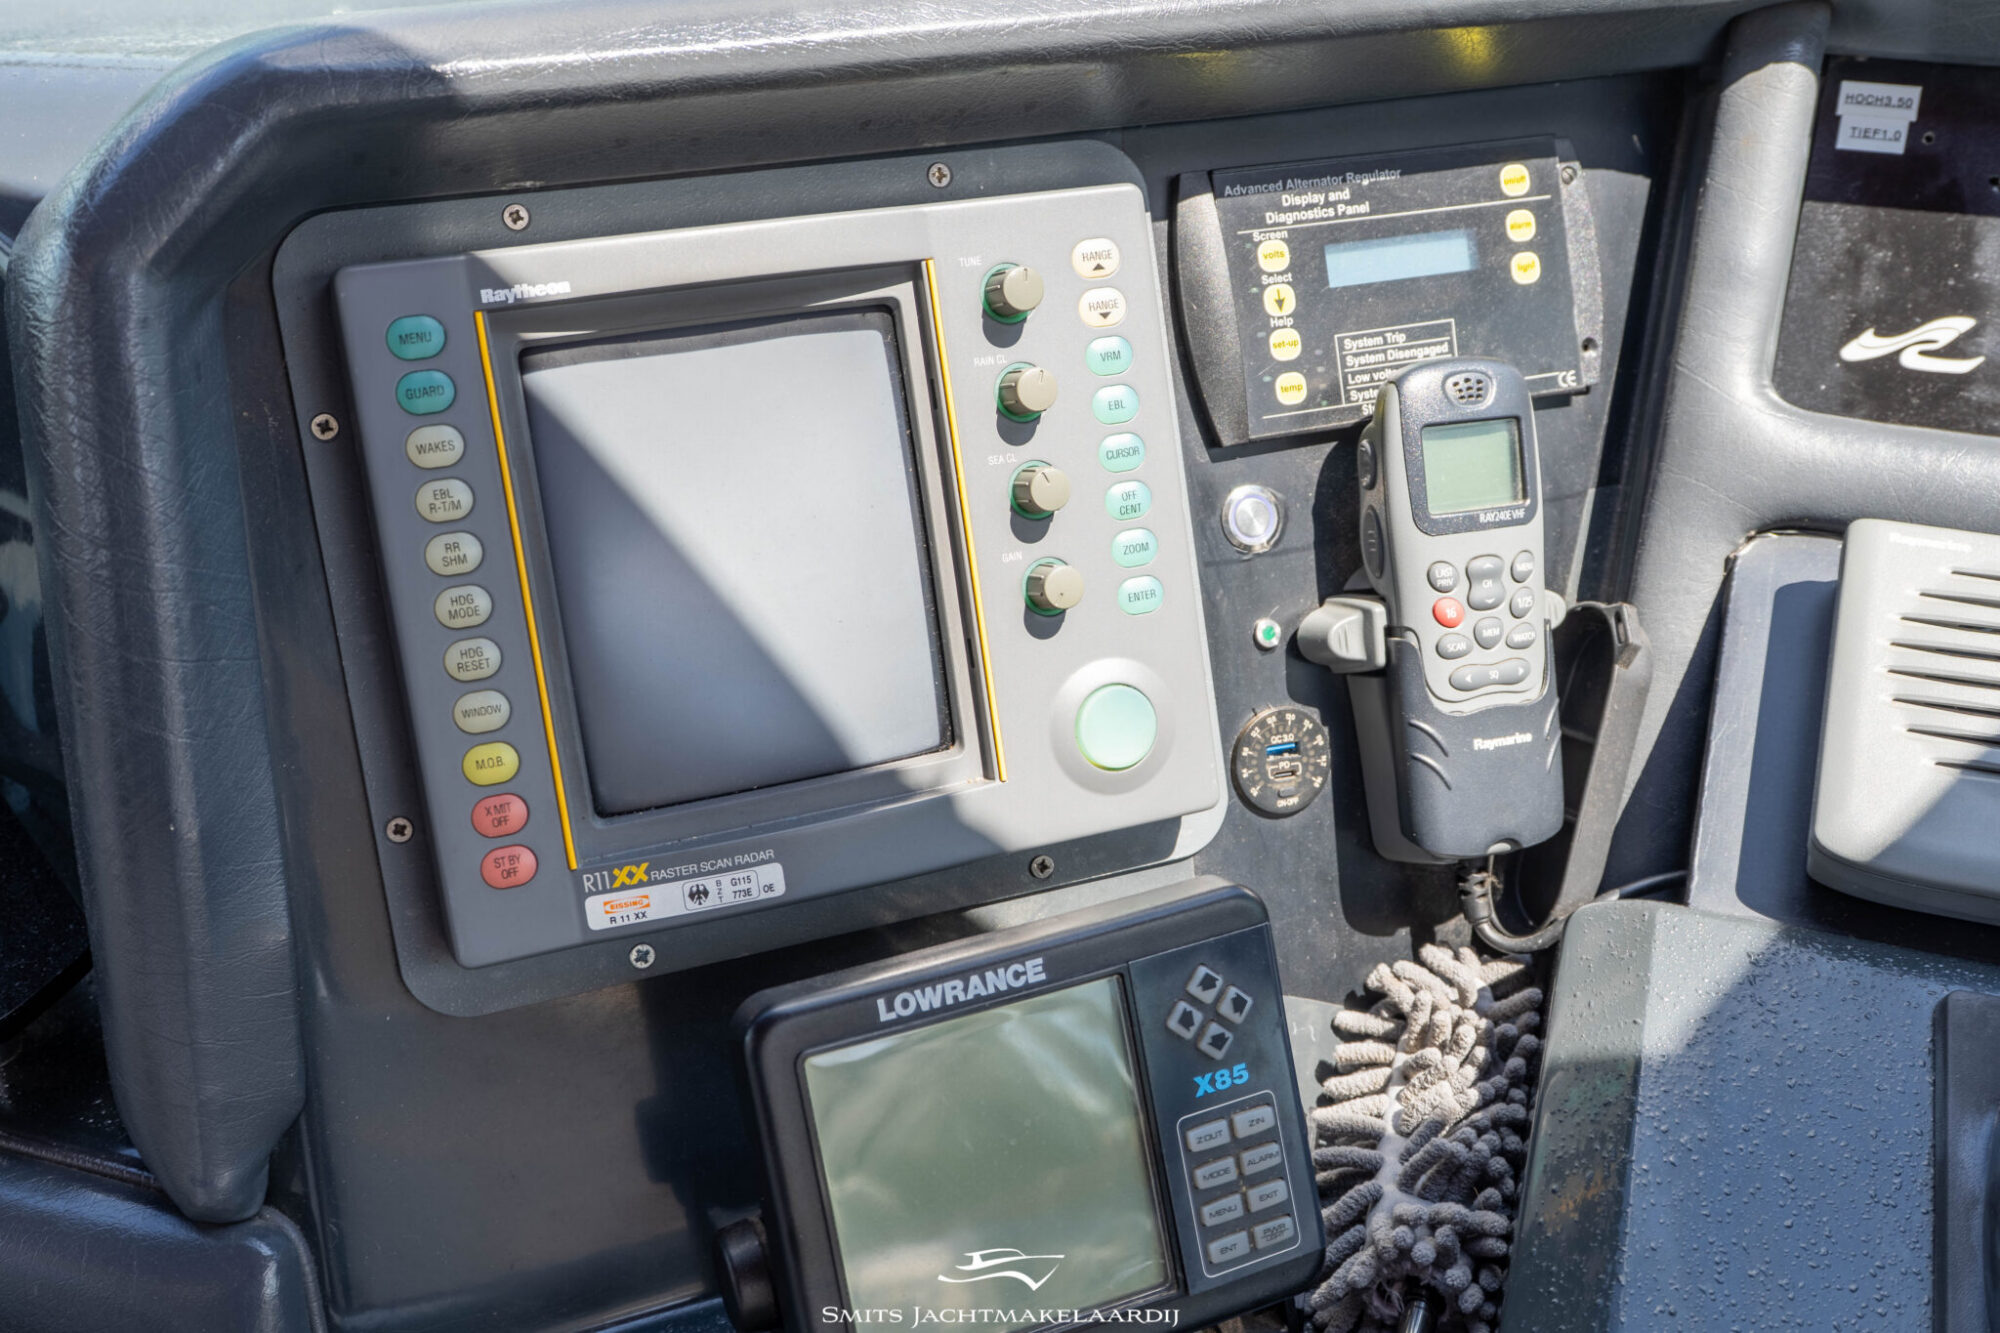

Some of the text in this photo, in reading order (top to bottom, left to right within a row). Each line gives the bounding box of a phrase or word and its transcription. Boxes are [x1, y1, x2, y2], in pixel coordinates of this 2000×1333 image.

[1224, 169, 1401, 197] Advanced Alternator Regulator
[1281, 189, 1350, 207] Display and
[1265, 202, 1370, 225] Diagnostics Panel
[1252, 231, 1288, 242] Screen
[958, 256, 982, 267] TUNE
[1263, 251, 1285, 259] volts
[1261, 272, 1292, 285] Select
[480, 281, 571, 304] Raytheon
[1270, 316, 1293, 328] Help
[399, 332, 432, 345] MENU
[1272, 337, 1299, 349] set-up
[1344, 331, 1406, 351] System Trip
[974, 355, 1007, 367] RAIN CL
[1100, 350, 1121, 362] VRM
[1346, 342, 1448, 367] System Disengaged
[1348, 368, 1399, 384] Low volt
[405, 385, 444, 400] GUARD
[1280, 383, 1303, 395] temp
[1108, 400, 1126, 410] EBL
[416, 440, 455, 455] WAKES
[1106, 446, 1140, 460] CURSOR
[988, 453, 1017, 465] SEA CL
[433, 488, 453, 500] EBL
[1122, 491, 1136, 501] OFF
[429, 500, 462, 514] R-T/M
[1120, 503, 1142, 515] CENT
[1480, 508, 1525, 523] RAY240E VHF
[445, 542, 460, 554] RR
[1123, 542, 1149, 555] ZOOM
[442, 554, 467, 567] SHM
[1002, 552, 1022, 562] GAIN
[450, 594, 474, 607] HDG
[1128, 589, 1156, 603] ENTER
[448, 606, 480, 621] MODE
[1447, 608, 1456, 618] 16
[1483, 627, 1500, 637] MEM
[460, 647, 483, 659] HDG
[1447, 642, 1466, 652] SCAN
[457, 659, 490, 673] RESET
[1489, 670, 1499, 680] SQ
[461, 704, 502, 720] WINDOW
[1473, 732, 1532, 750] Raymarine
[476, 756, 505, 770] M.O.B.
[1279, 761, 1290, 769] PD
[492, 816, 510, 828] OFF
[494, 854, 521, 869] ST BY
[650, 866, 698, 881] RASTER
[700, 858, 733, 873] SCAN
[734, 849, 775, 866] RADAR
[501, 867, 519, 879] OFF
[730, 876, 752, 886] G115
[732, 890, 752, 899] 773E
[621, 914, 631, 922] 11
[634, 911, 648, 920] XX
[877, 957, 1046, 1023] LOWRANCE
[1193, 1063, 1249, 1098] X85
[1246, 1150, 1280, 1166] ALARM
[1203, 1167, 1231, 1181] MODE
[1259, 1189, 1279, 1201] EXIT
[1209, 1204, 1237, 1218] MENU
[1264, 1223, 1286, 1236] PWR
[1220, 1243, 1237, 1256] ENT
